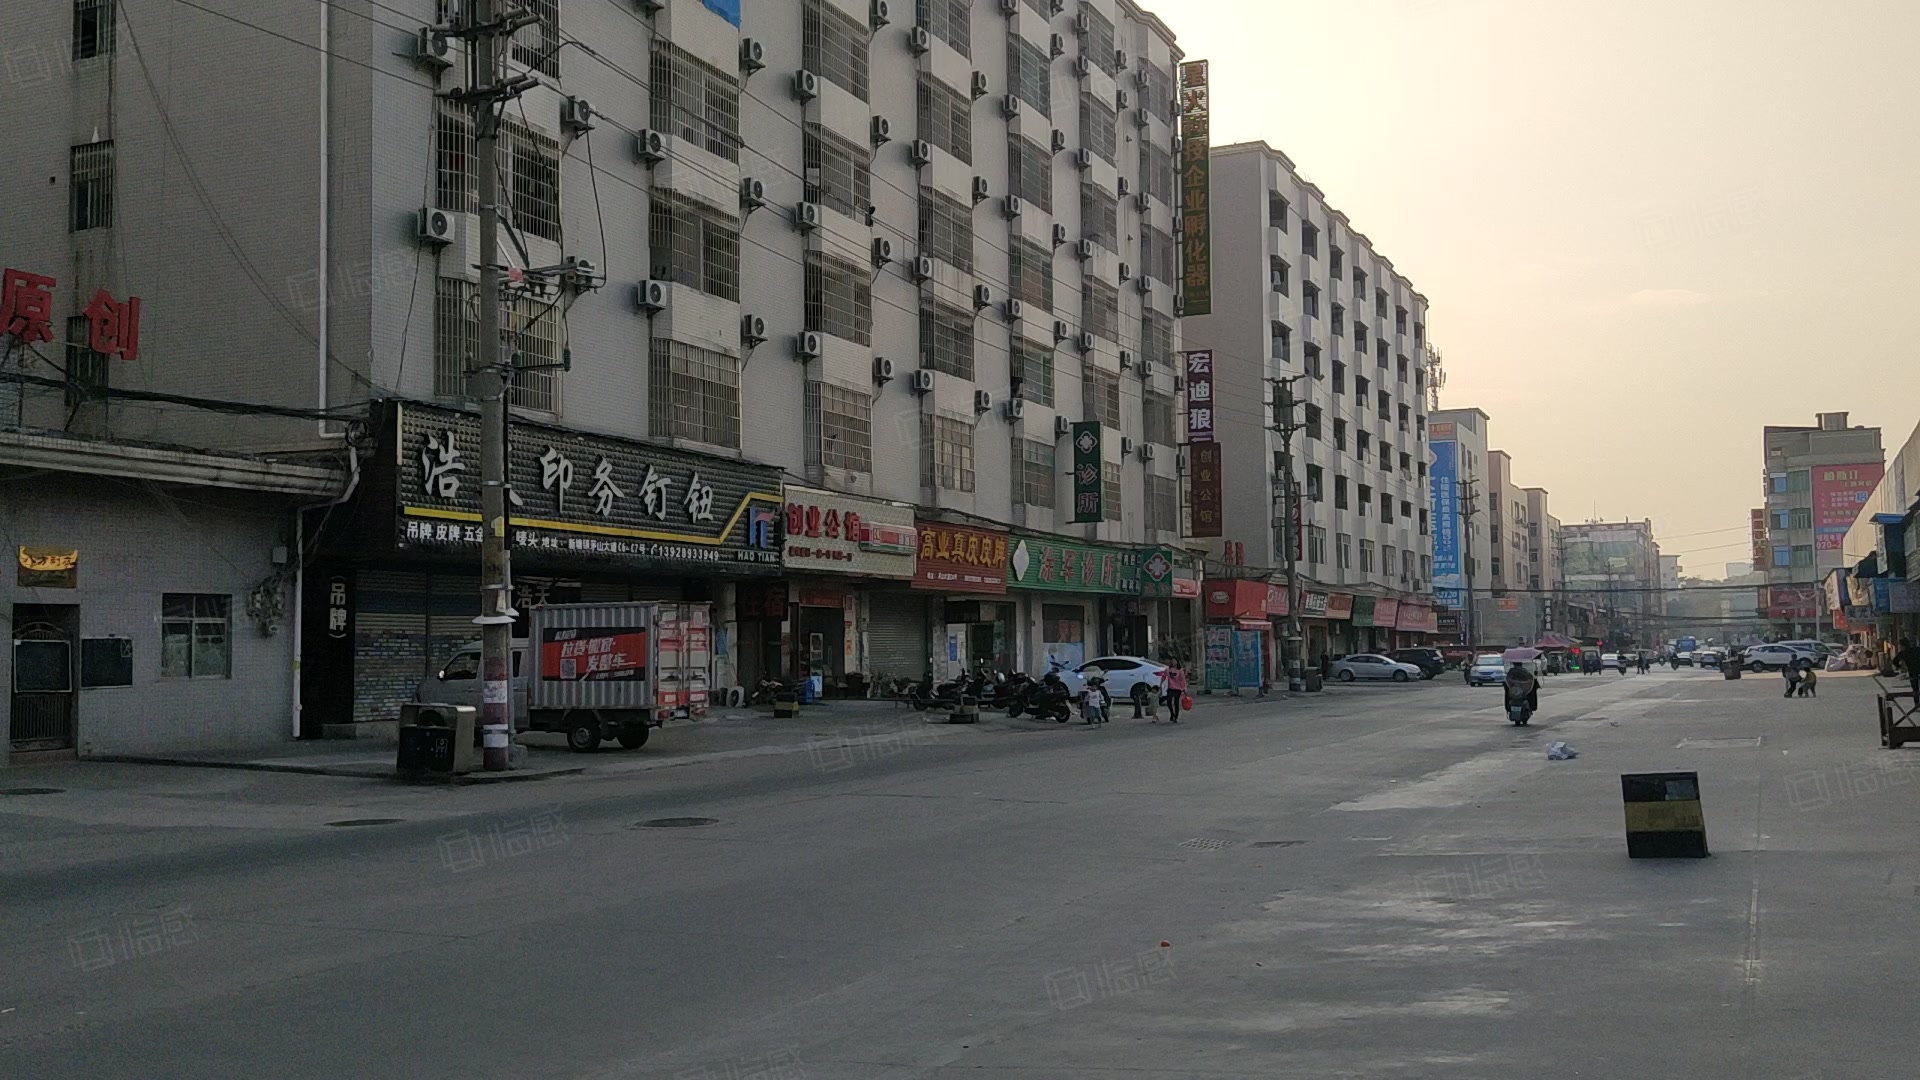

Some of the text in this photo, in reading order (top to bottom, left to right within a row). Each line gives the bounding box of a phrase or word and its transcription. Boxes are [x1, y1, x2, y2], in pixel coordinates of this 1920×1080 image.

[0, 268, 140, 360] 原创
[1188, 352, 1212, 430] 宏迪狼
[421, 428, 715, 524] 浩印务钉钮
[1075, 463, 1099, 514] 诊所
[1199, 448, 1214, 523] 创业公馆
[406, 521, 433, 540] 吊牌
[436, 523, 461, 542] 皮牌
[658, 545, 719, 562] 13928933949
[787, 503, 861, 542] 创业公馆
[737, 550, 755, 562] HAO
[758, 552, 775, 563] TIAN
[515, 584, 551, 609] 浩天
